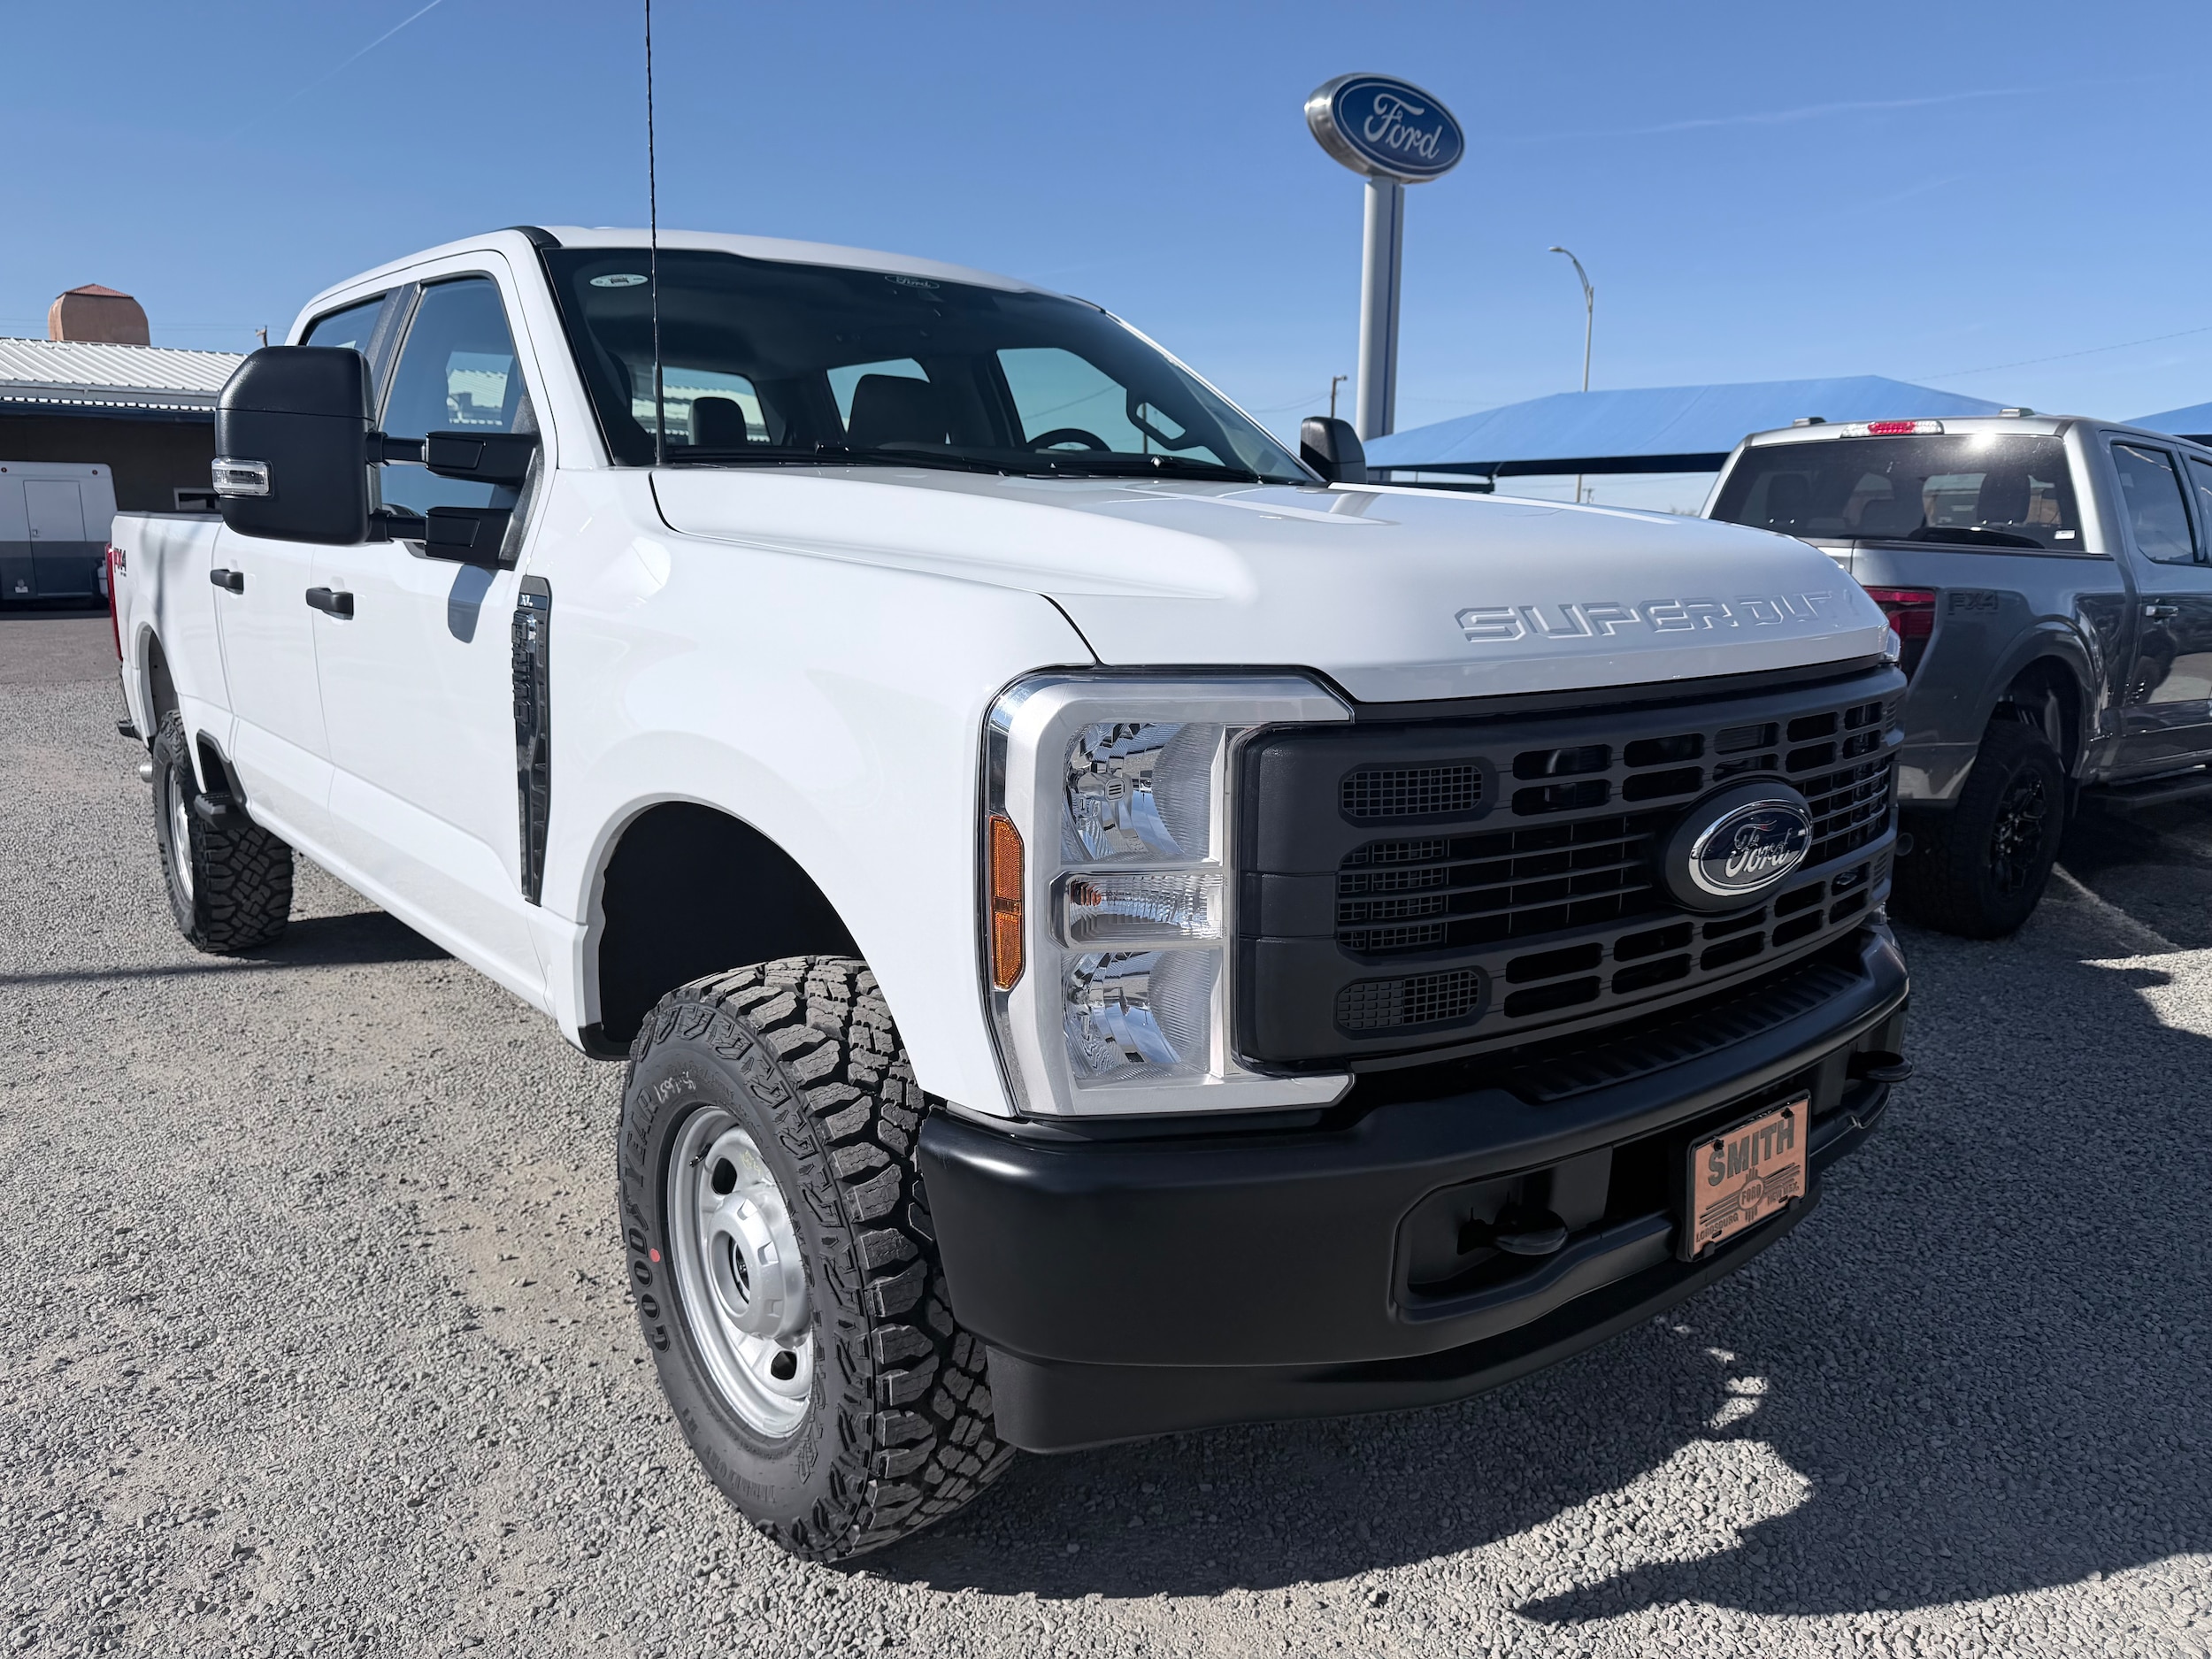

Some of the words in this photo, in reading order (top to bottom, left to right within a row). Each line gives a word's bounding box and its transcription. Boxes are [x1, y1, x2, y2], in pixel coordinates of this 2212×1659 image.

[1363, 93, 1443, 159] Ford
[1454, 597, 1739, 642] SUPER
[1947, 590, 1999, 616] FX4
[1725, 819, 1793, 878] Ford
[1708, 1113, 1795, 1187] SMITH
[623, 1087, 670, 1353] GOODYEAR
[1740, 1183, 1762, 1205] FORD
